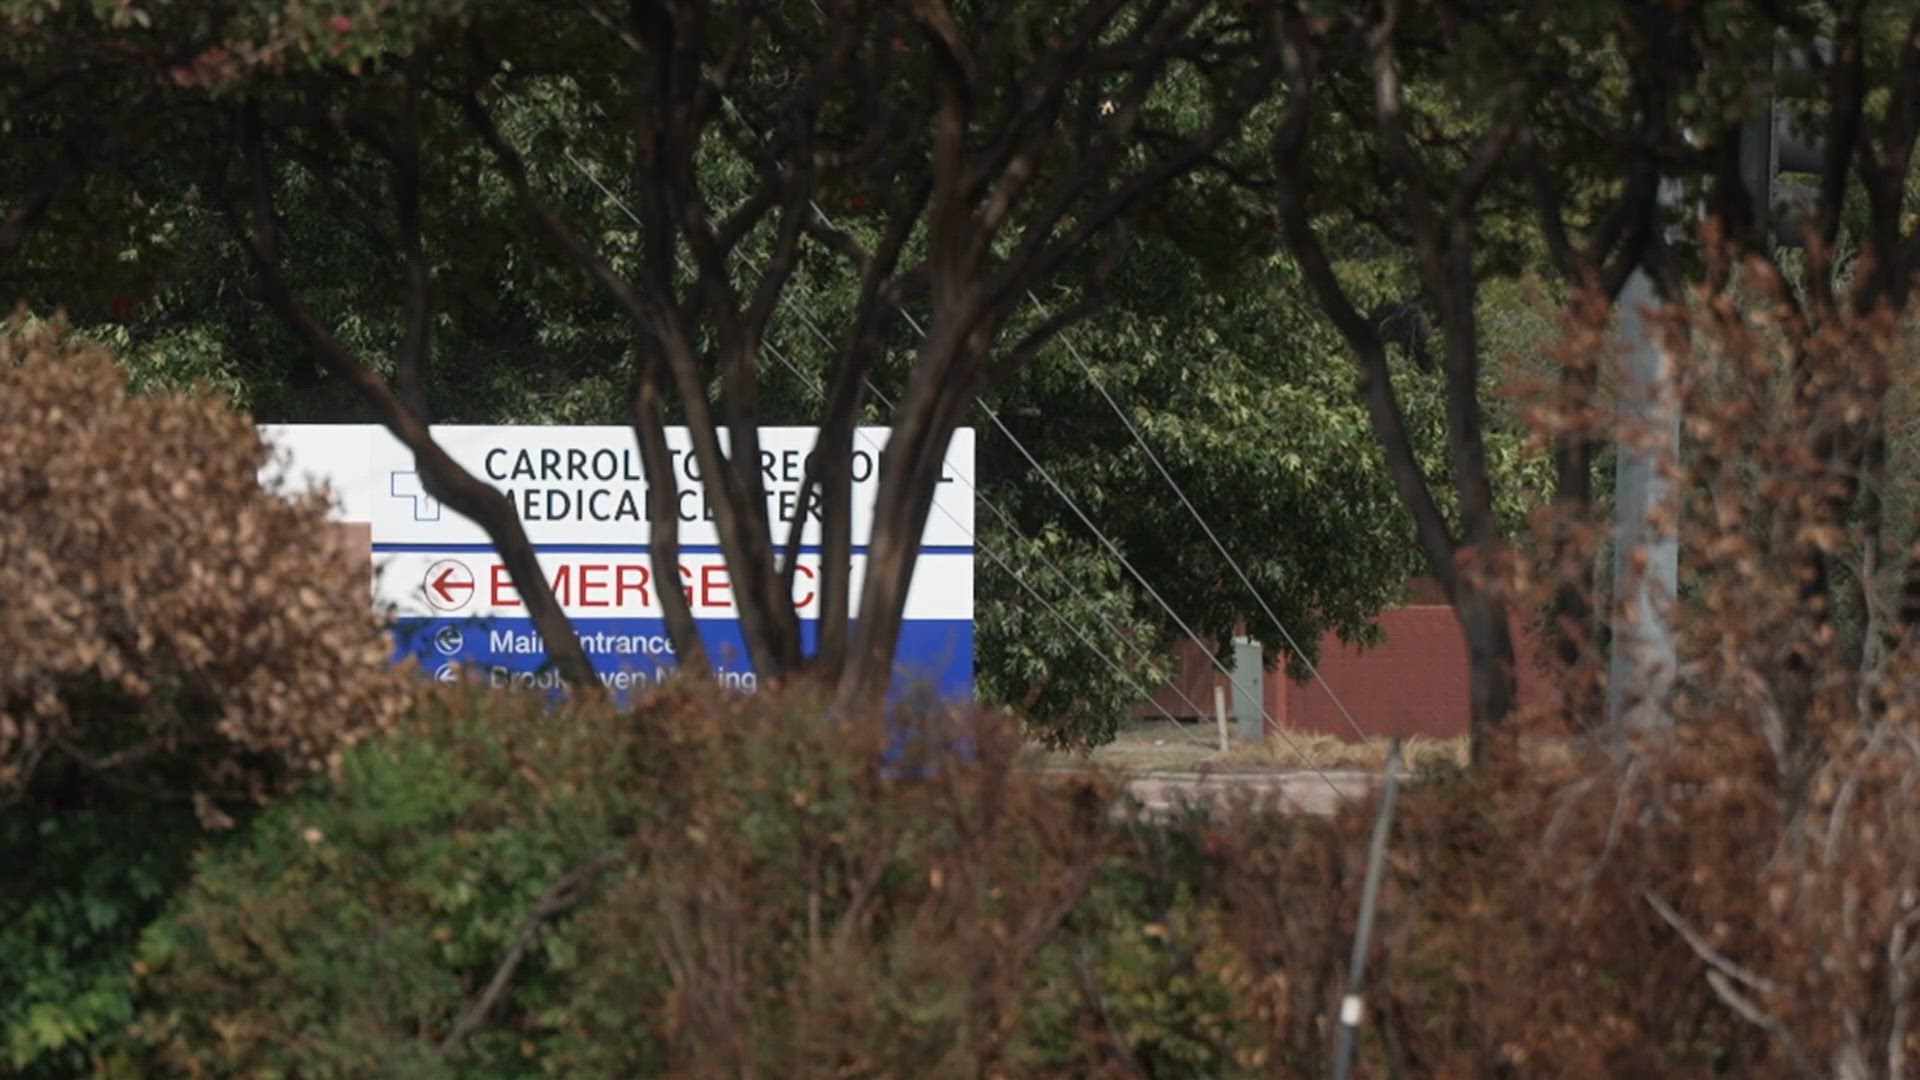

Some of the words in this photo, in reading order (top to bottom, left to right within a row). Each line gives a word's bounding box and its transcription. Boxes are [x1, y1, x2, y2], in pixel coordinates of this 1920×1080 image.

[485, 448, 734, 482] CARROLTO
[490, 488, 657, 521] EDICAL
[679, 489, 826, 523] CETER
[490, 564, 853, 609] EMERGEC
[563, 631, 681, 655] ntrance
[489, 665, 647, 690] Brookven
[656, 666, 757, 693] Ning
